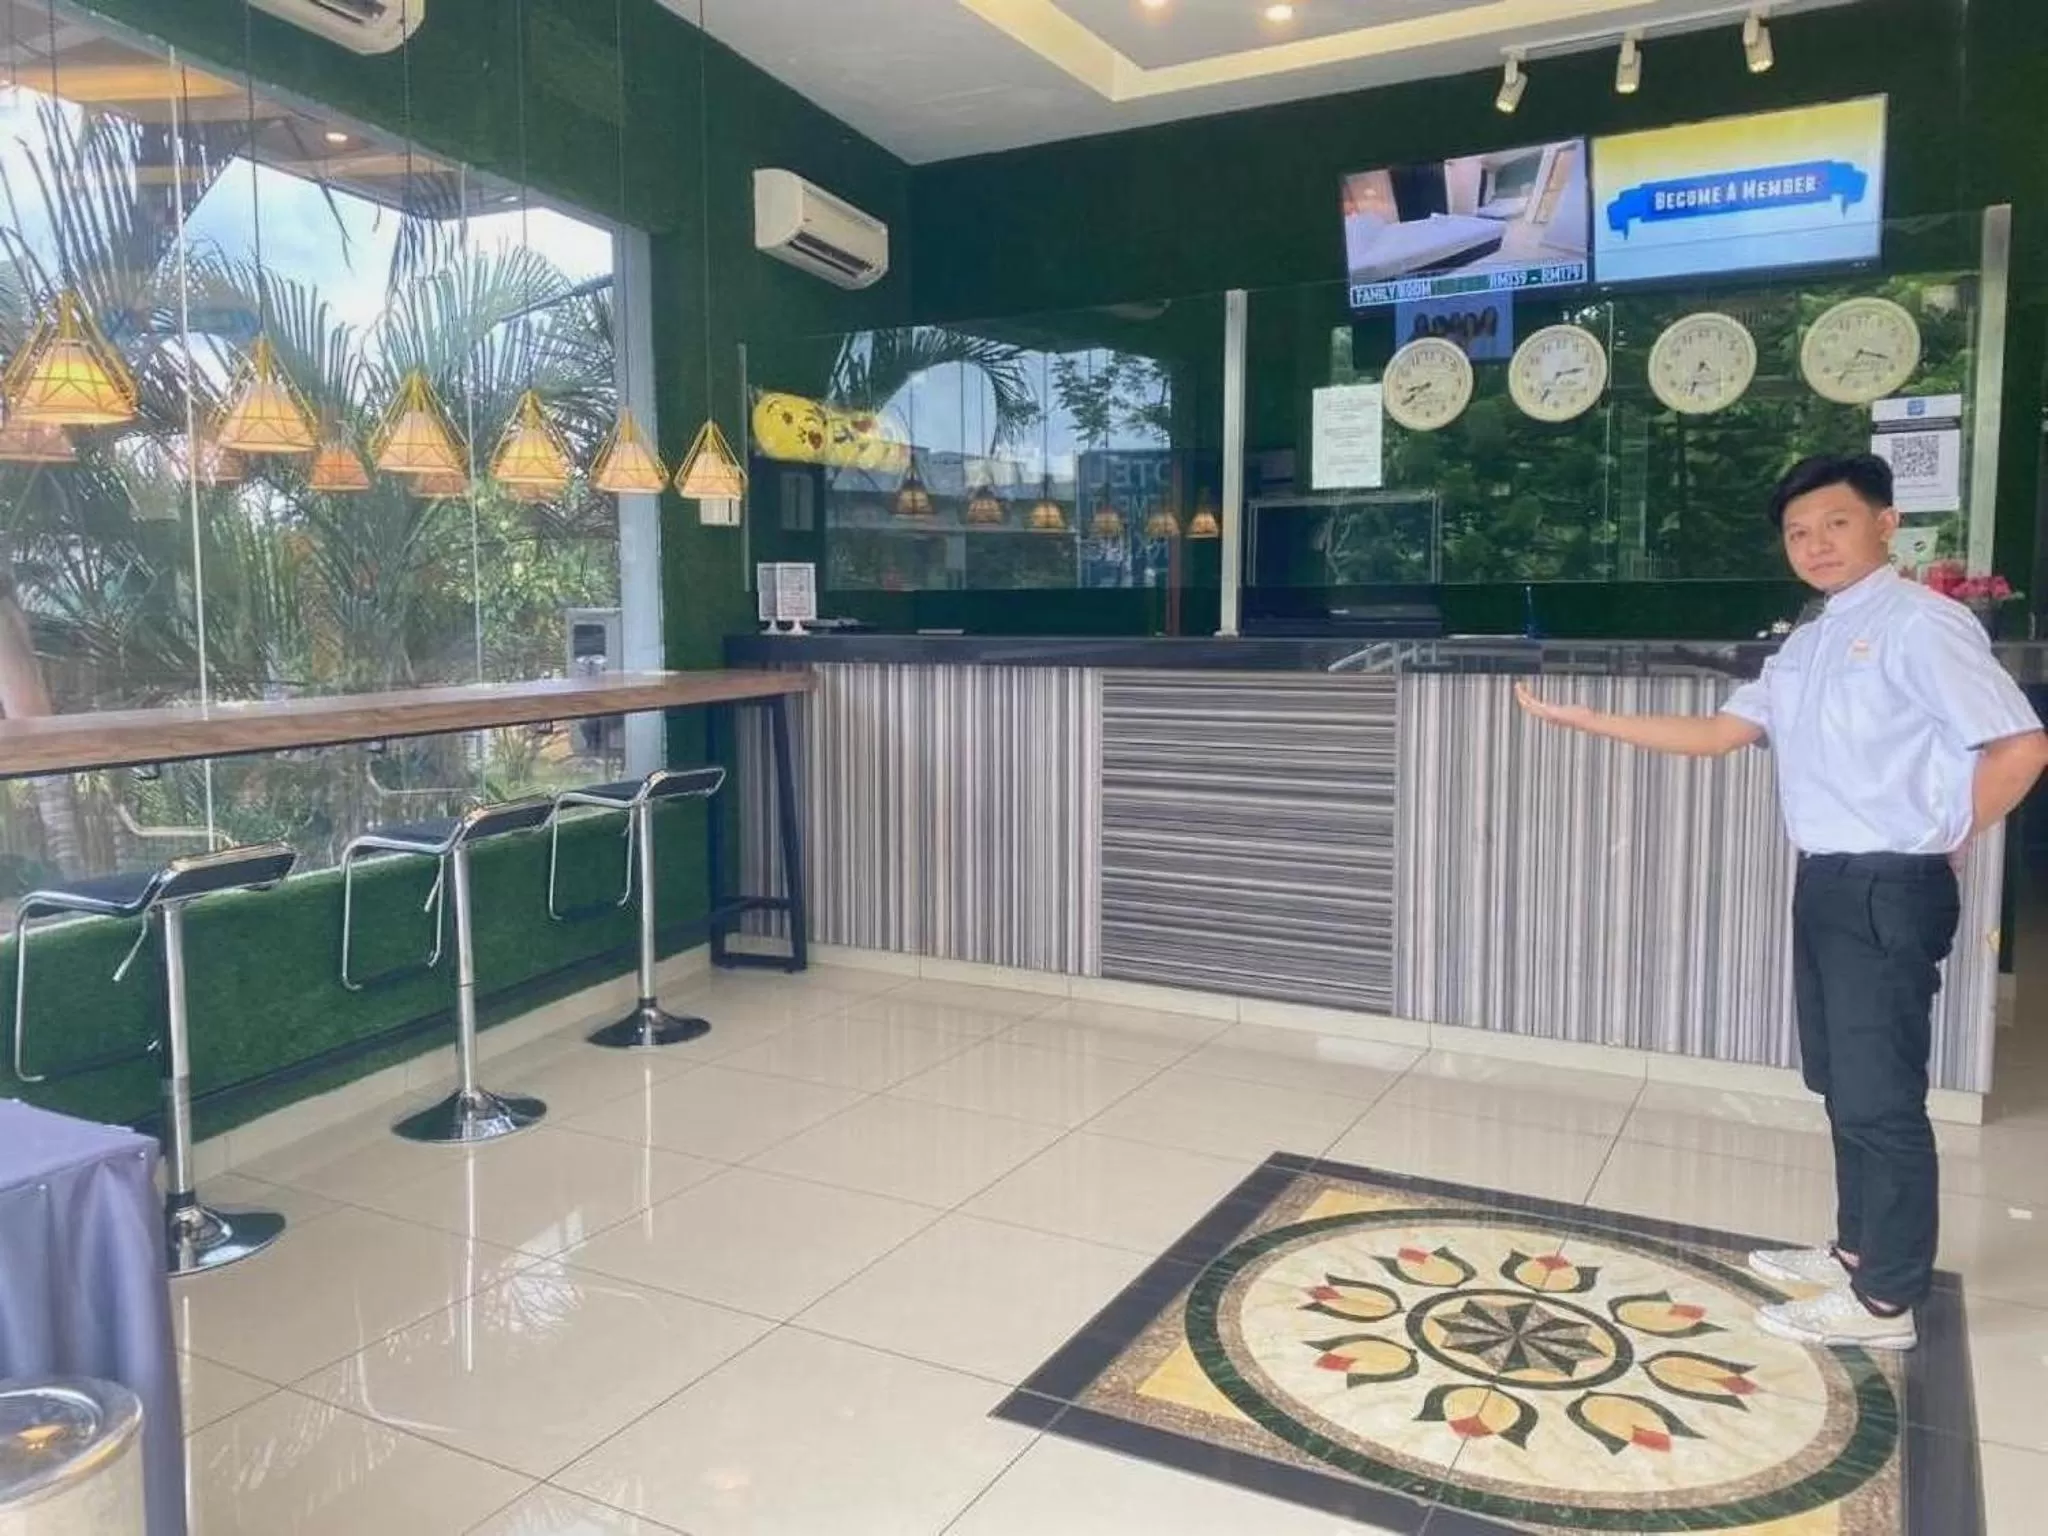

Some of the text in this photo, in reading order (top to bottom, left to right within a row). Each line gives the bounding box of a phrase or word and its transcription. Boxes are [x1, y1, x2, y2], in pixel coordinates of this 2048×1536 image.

[1654, 176, 1816, 211] BECOME A MEMBER
[1356, 284, 1396, 302] FAMILY
